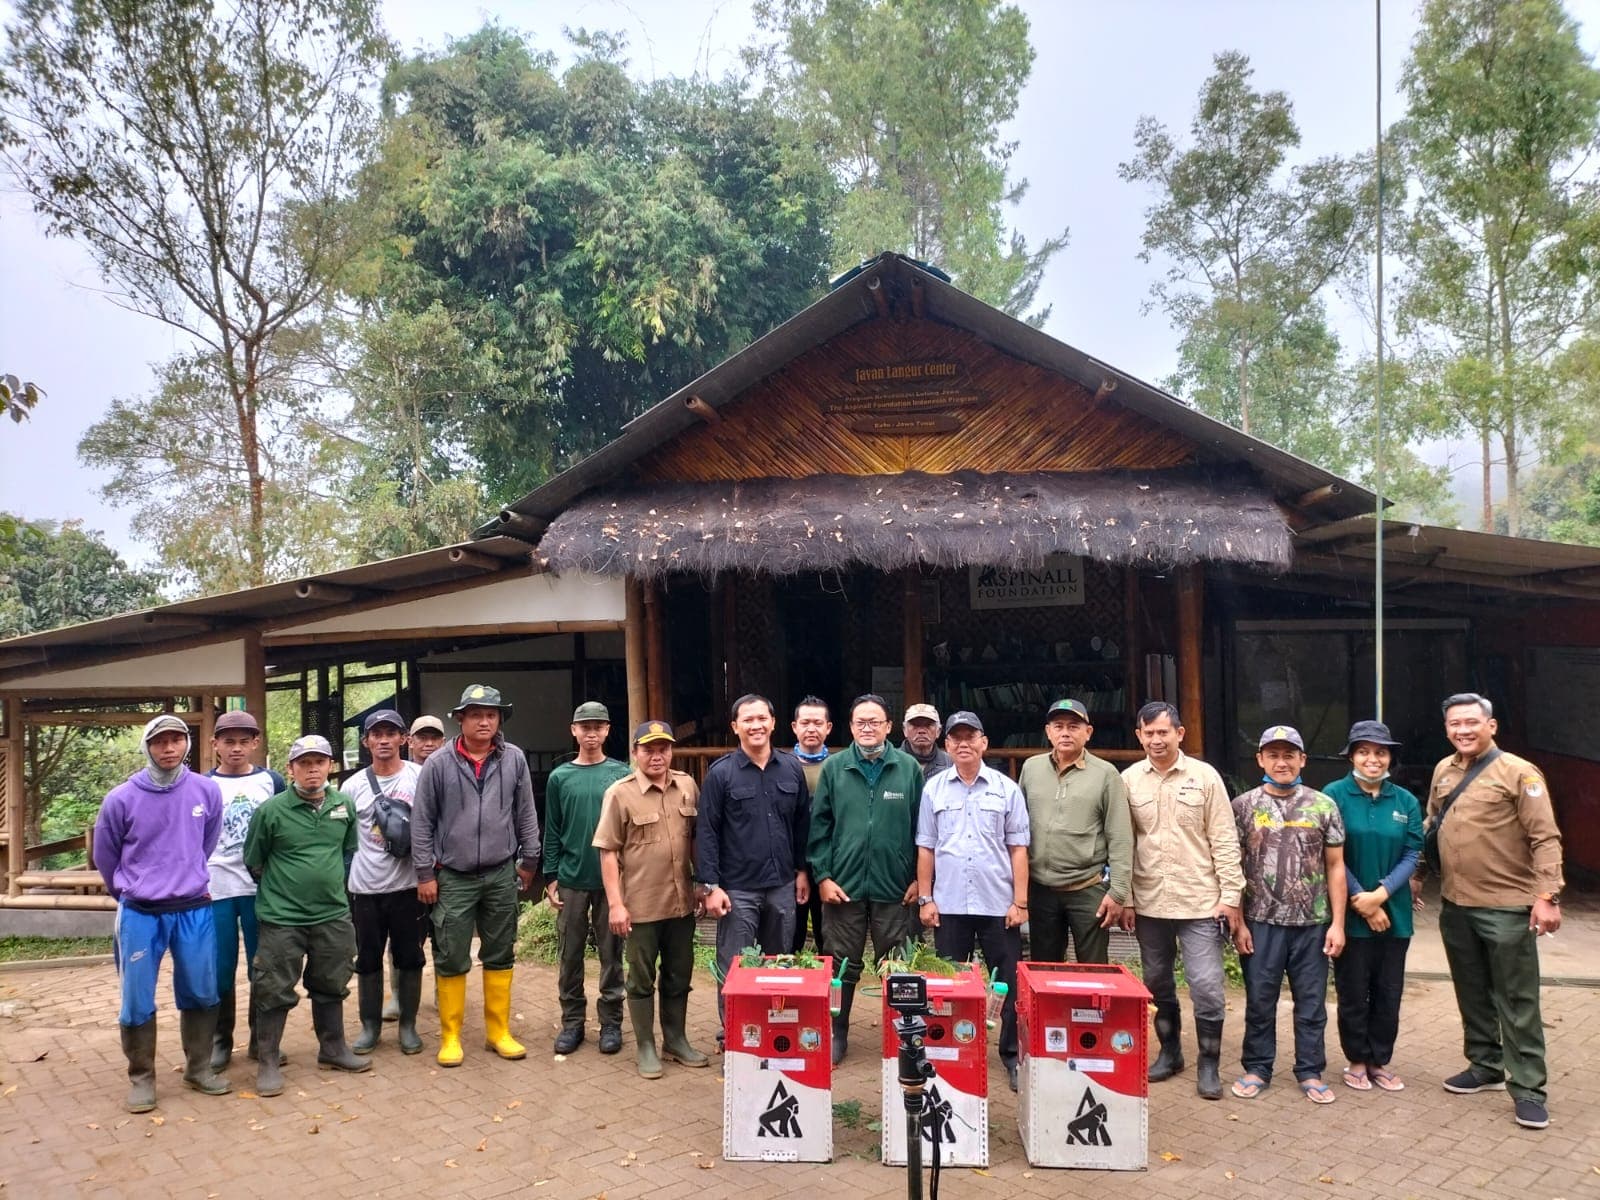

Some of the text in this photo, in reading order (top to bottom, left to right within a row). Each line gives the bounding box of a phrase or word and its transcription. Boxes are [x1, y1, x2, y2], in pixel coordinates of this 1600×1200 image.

[886, 365, 921, 379] Langur
[923, 362, 957, 376] Center
[978, 584, 1077, 599] FOUNDATION
